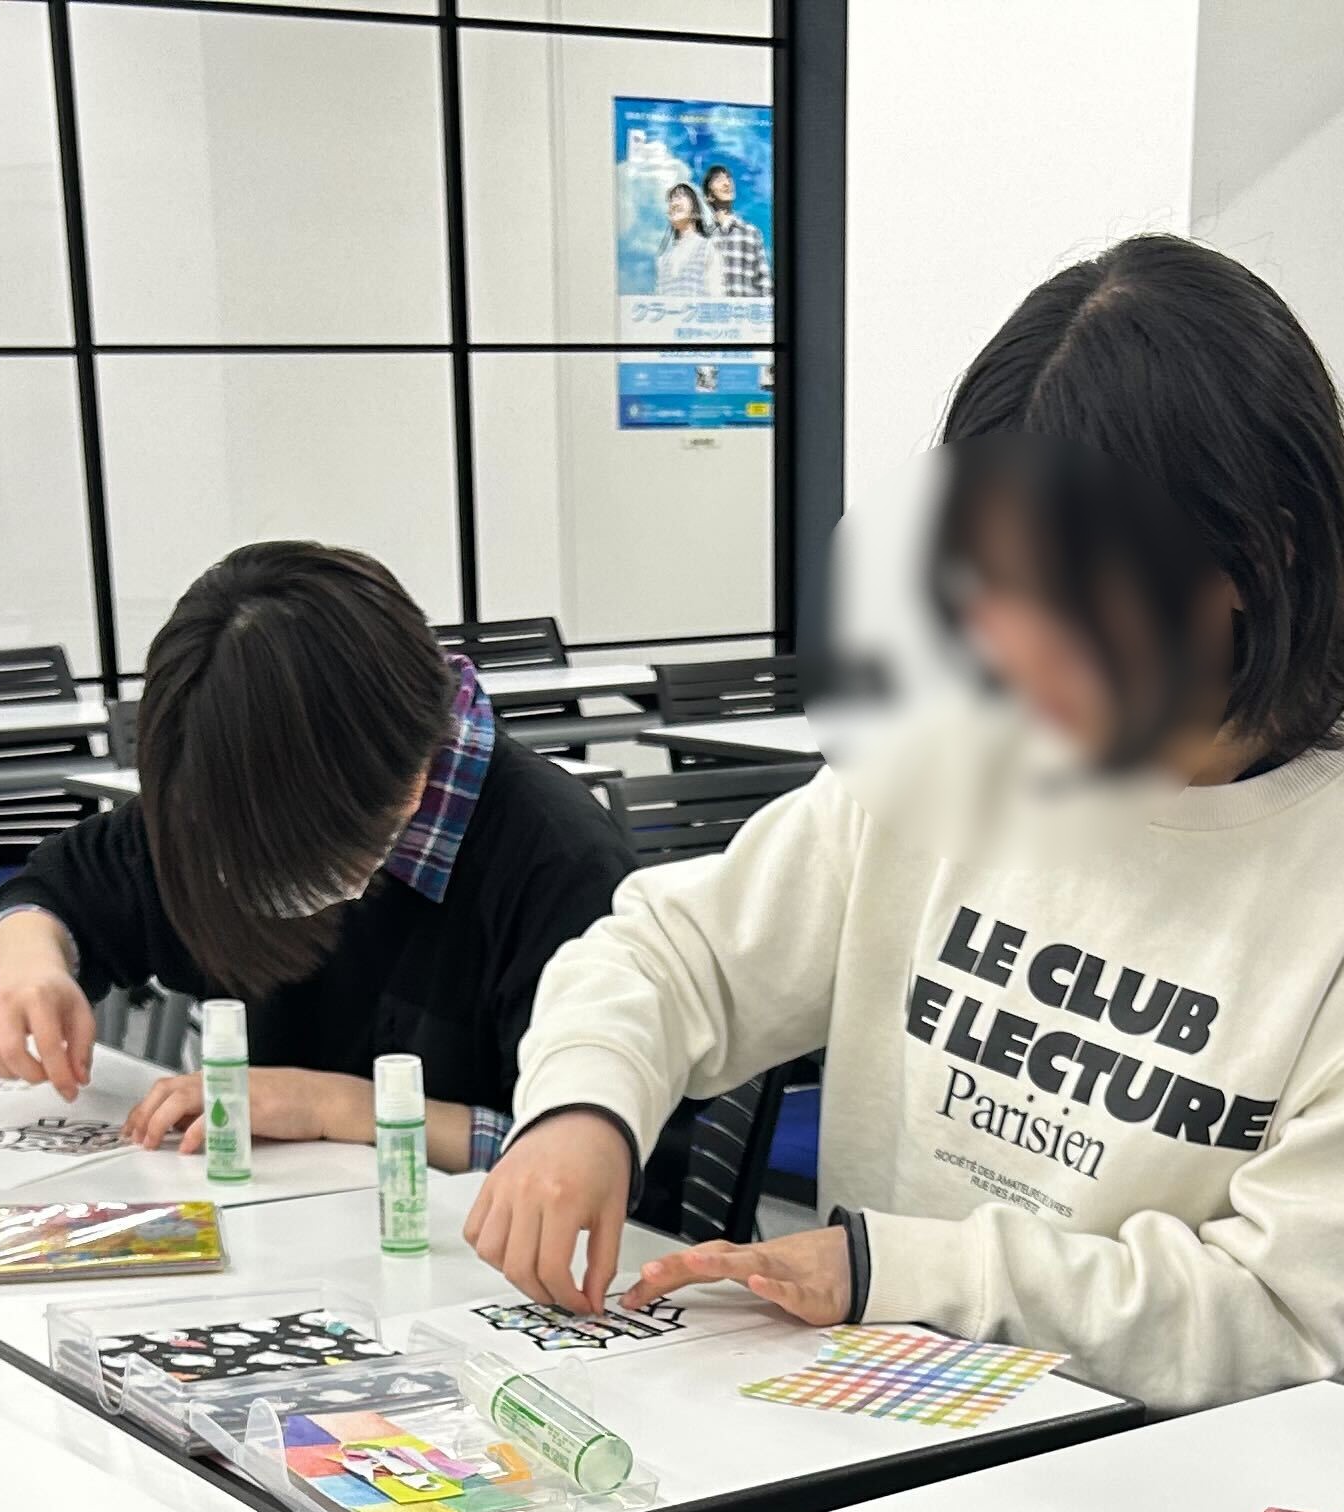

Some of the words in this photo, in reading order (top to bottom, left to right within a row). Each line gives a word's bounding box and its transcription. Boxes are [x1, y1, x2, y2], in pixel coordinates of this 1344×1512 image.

[938, 905, 1027, 988] LE
[1027, 943, 1219, 1055] CLUB
[905, 974, 953, 1045] E
[942, 996, 1278, 1151] LECTURE
[936, 1065, 1105, 1179] Parisien
